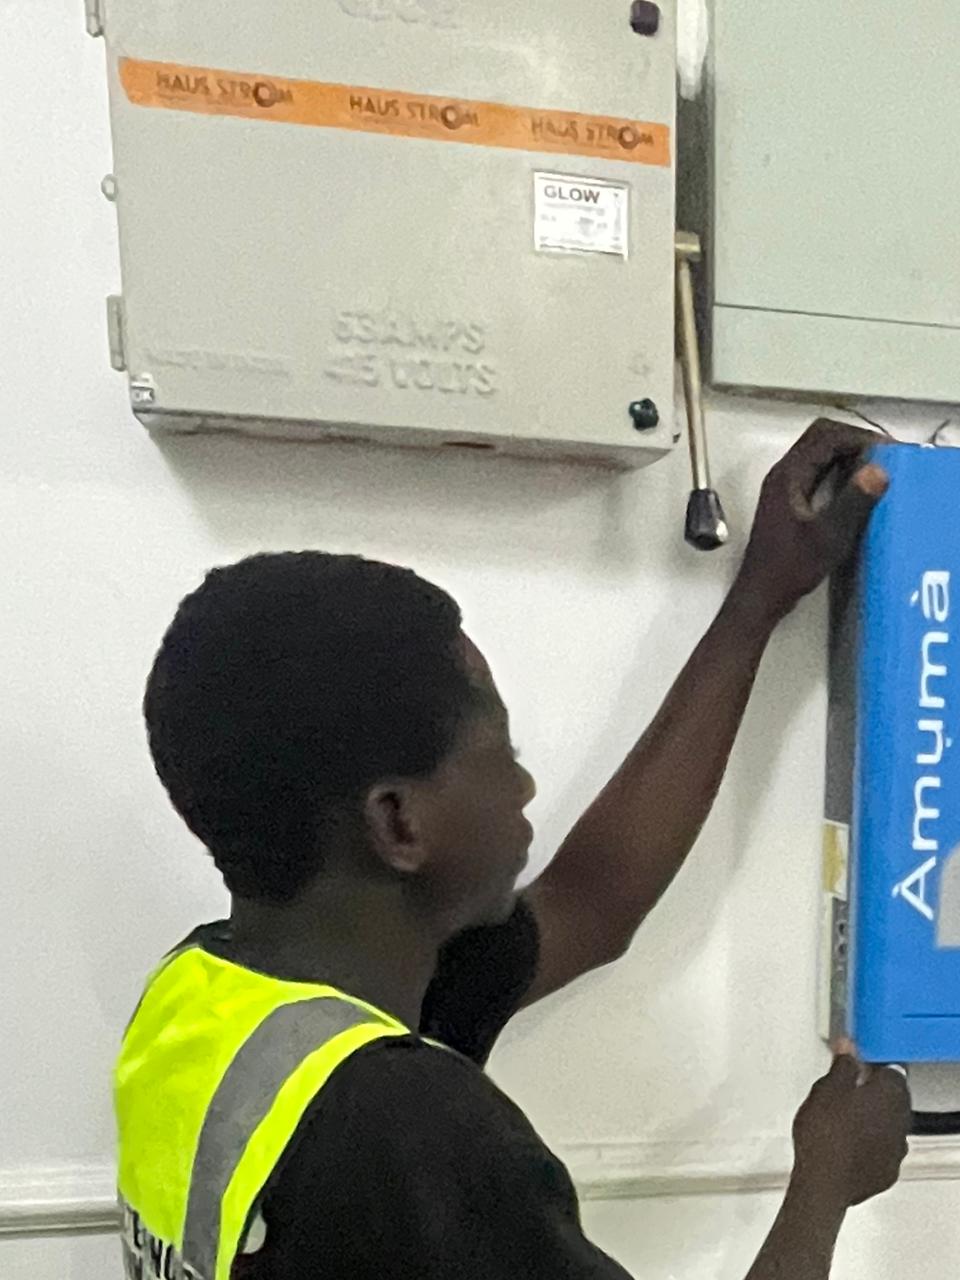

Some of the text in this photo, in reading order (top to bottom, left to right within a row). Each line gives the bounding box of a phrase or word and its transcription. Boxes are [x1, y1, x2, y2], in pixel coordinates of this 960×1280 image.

[156, 71, 210, 96] HAUS
[216, 78, 293, 108] STROM
[349, 94, 479, 130] HAUS STROM
[530, 117, 578, 142] HAUS
[543, 184, 601, 204] GLOW
